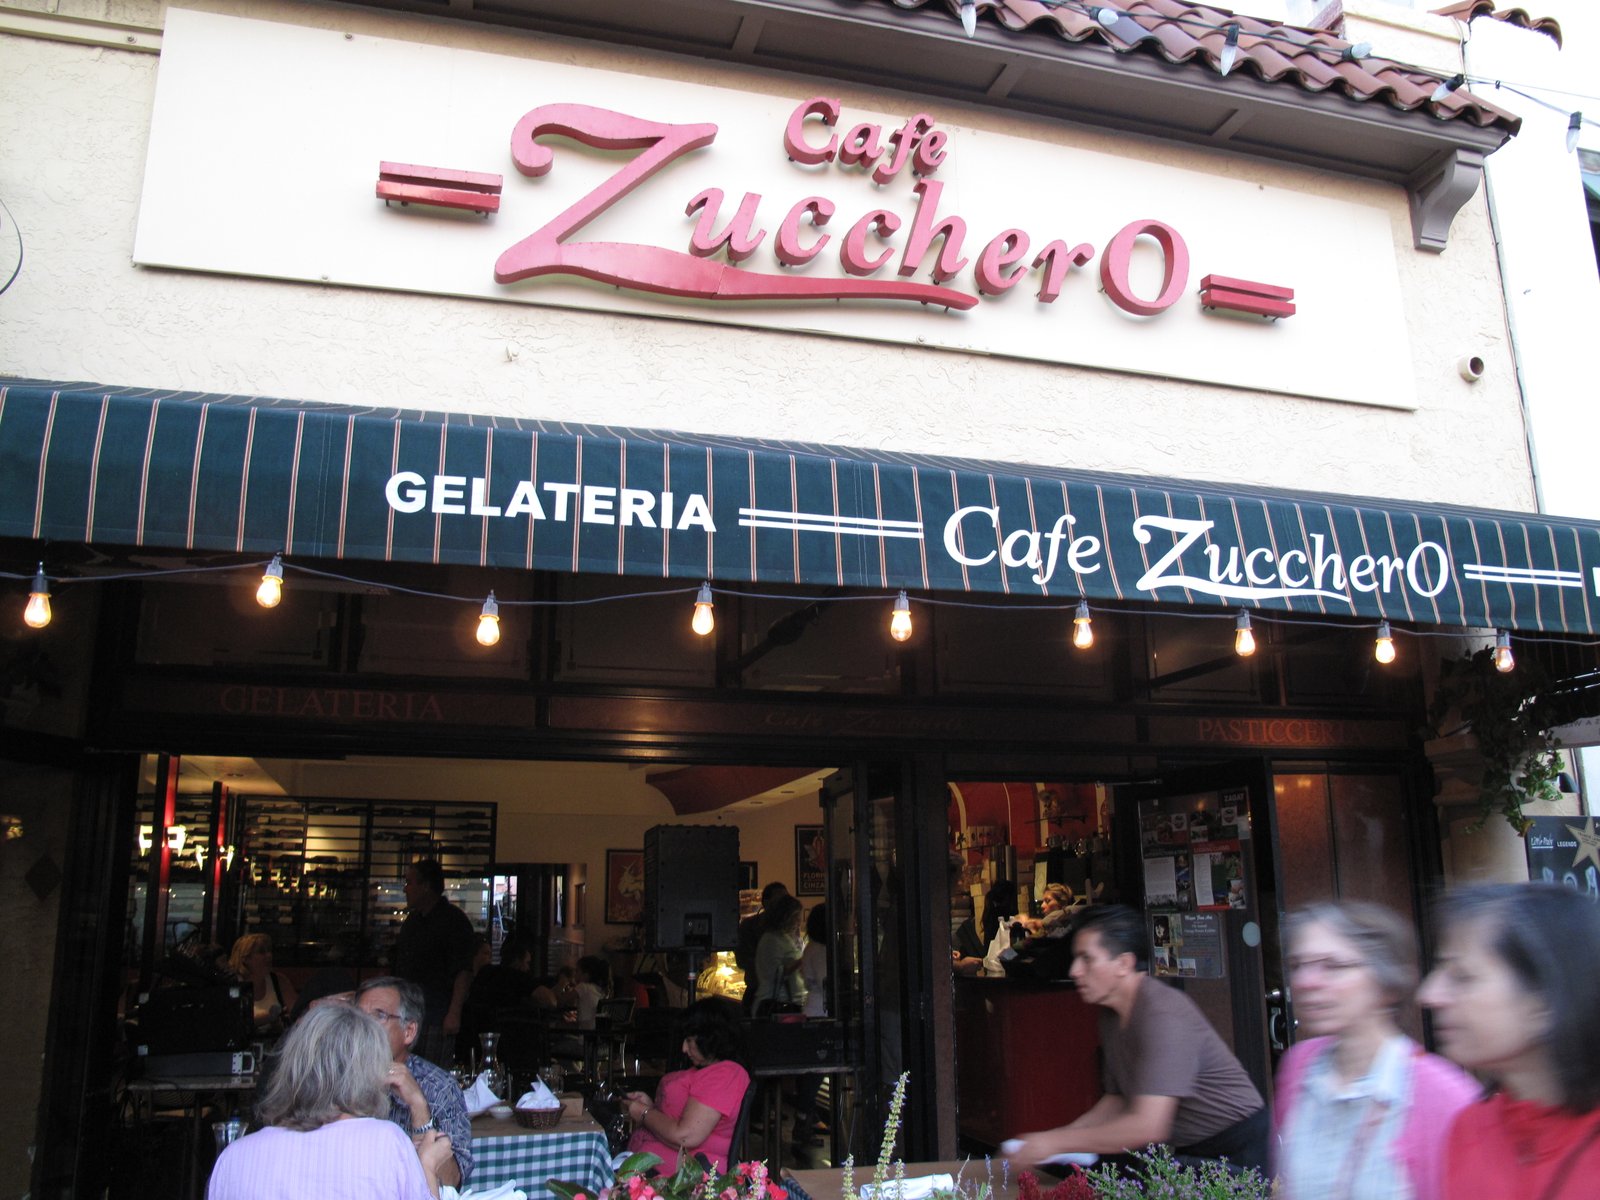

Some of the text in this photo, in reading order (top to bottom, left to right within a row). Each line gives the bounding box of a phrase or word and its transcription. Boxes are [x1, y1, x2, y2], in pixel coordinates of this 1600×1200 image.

[784, 97, 947, 186] Cafe
[385, 471, 717, 533] GELATERIA
[943, 504, 1101, 585] Cafe
[219, 685, 444, 721] GELATERIA
[1198, 718, 1364, 744] PASTICCERIA
